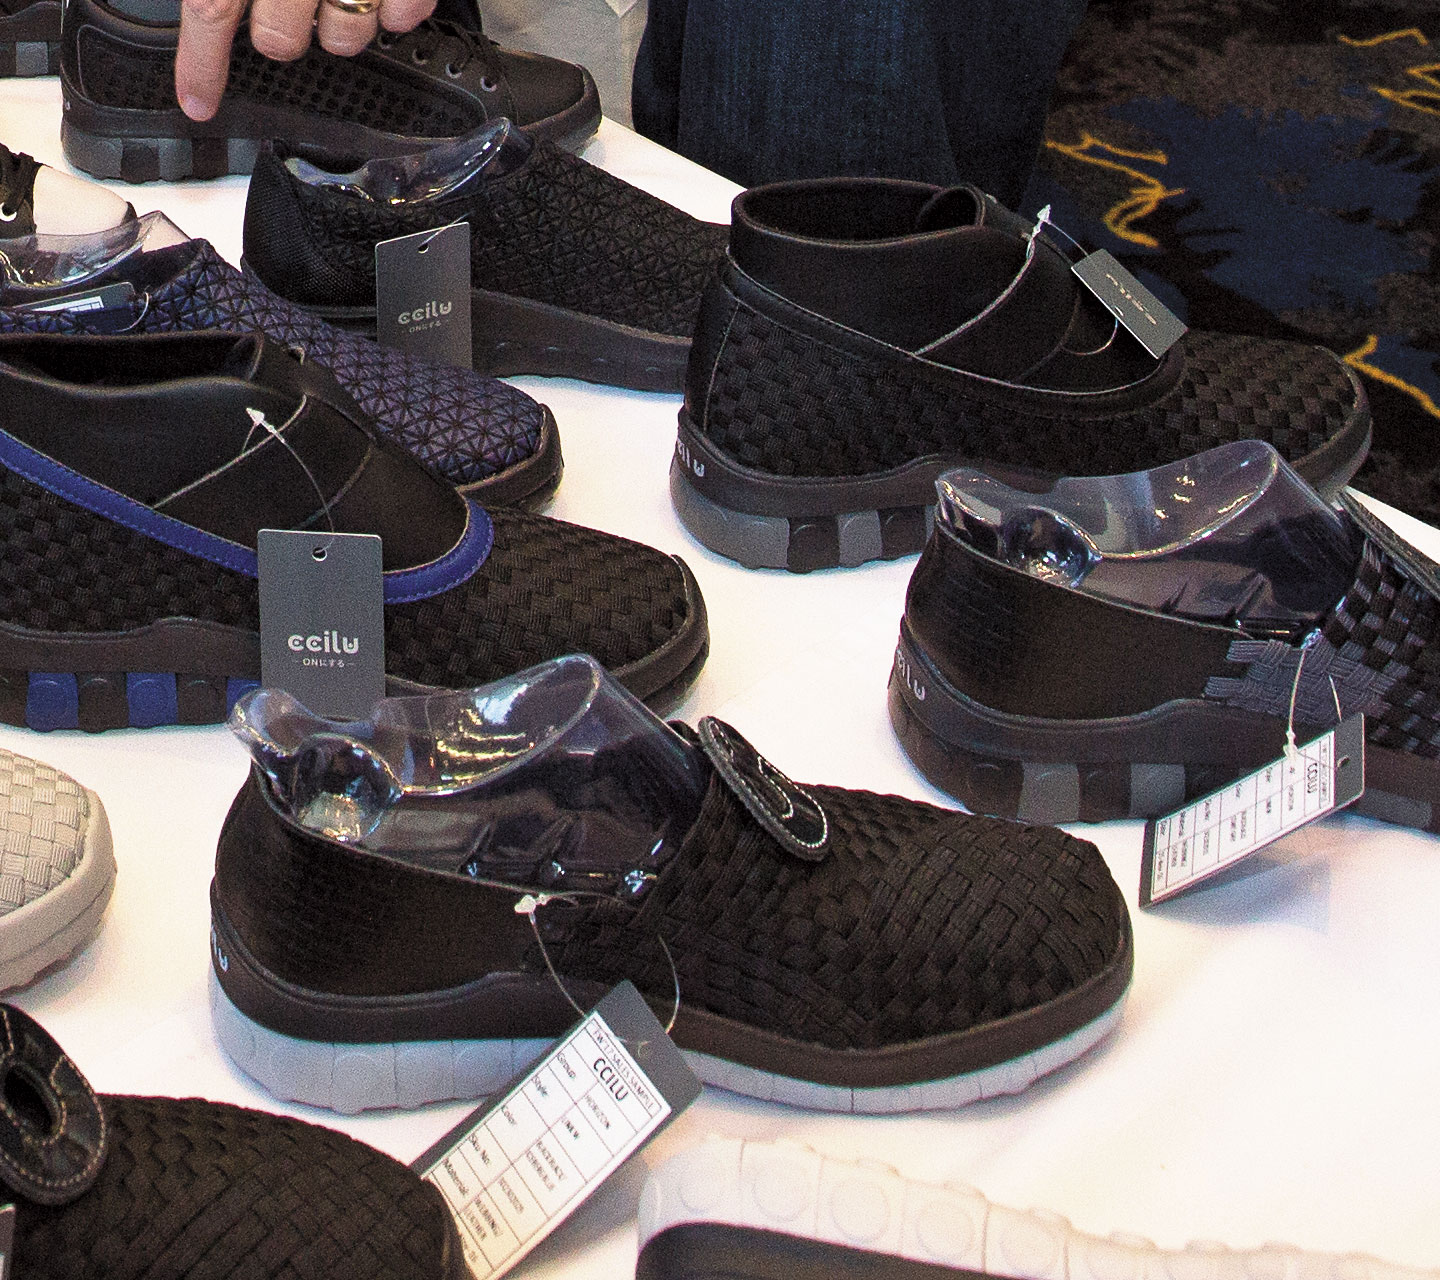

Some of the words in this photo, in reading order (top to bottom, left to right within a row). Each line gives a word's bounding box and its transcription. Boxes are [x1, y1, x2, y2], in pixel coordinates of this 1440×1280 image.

[398, 301, 452, 325] ccilu
[287, 630, 359, 654] ccilu
[593, 1059, 627, 1100] CCILU
